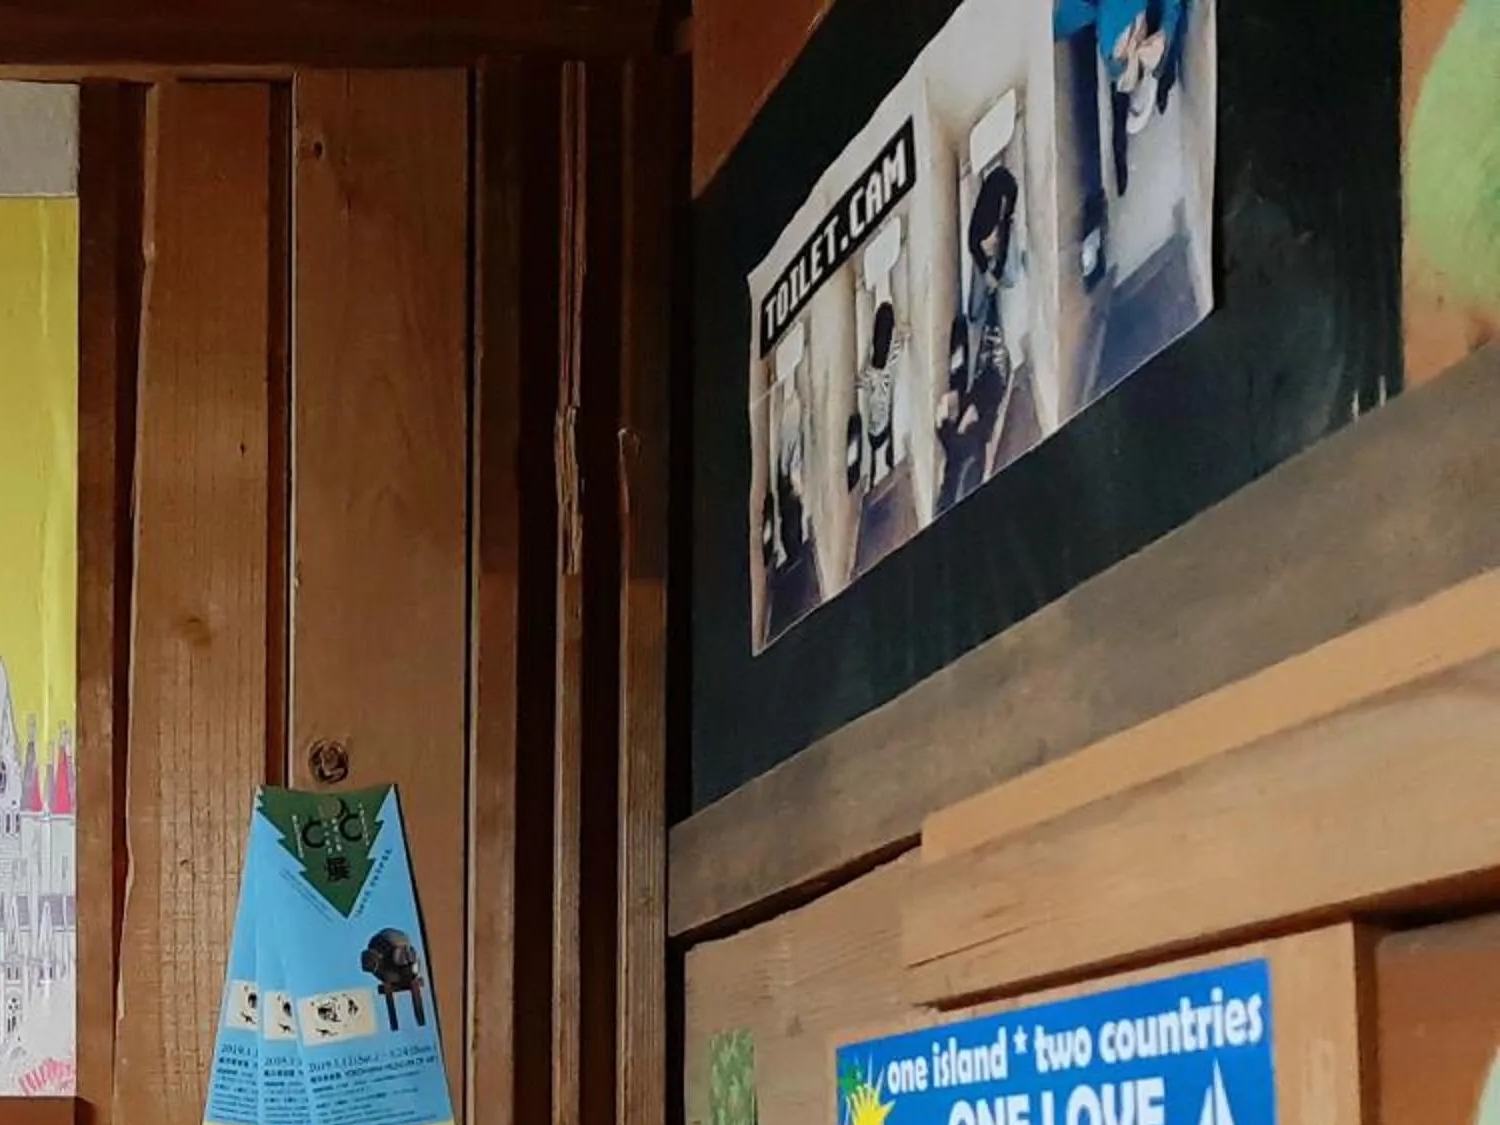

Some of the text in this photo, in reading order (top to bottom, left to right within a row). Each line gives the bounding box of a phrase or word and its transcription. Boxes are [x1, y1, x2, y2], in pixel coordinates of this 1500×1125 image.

[764, 138, 908, 340] TOILET.CAM
[886, 986, 1265, 1095] one island two countries
